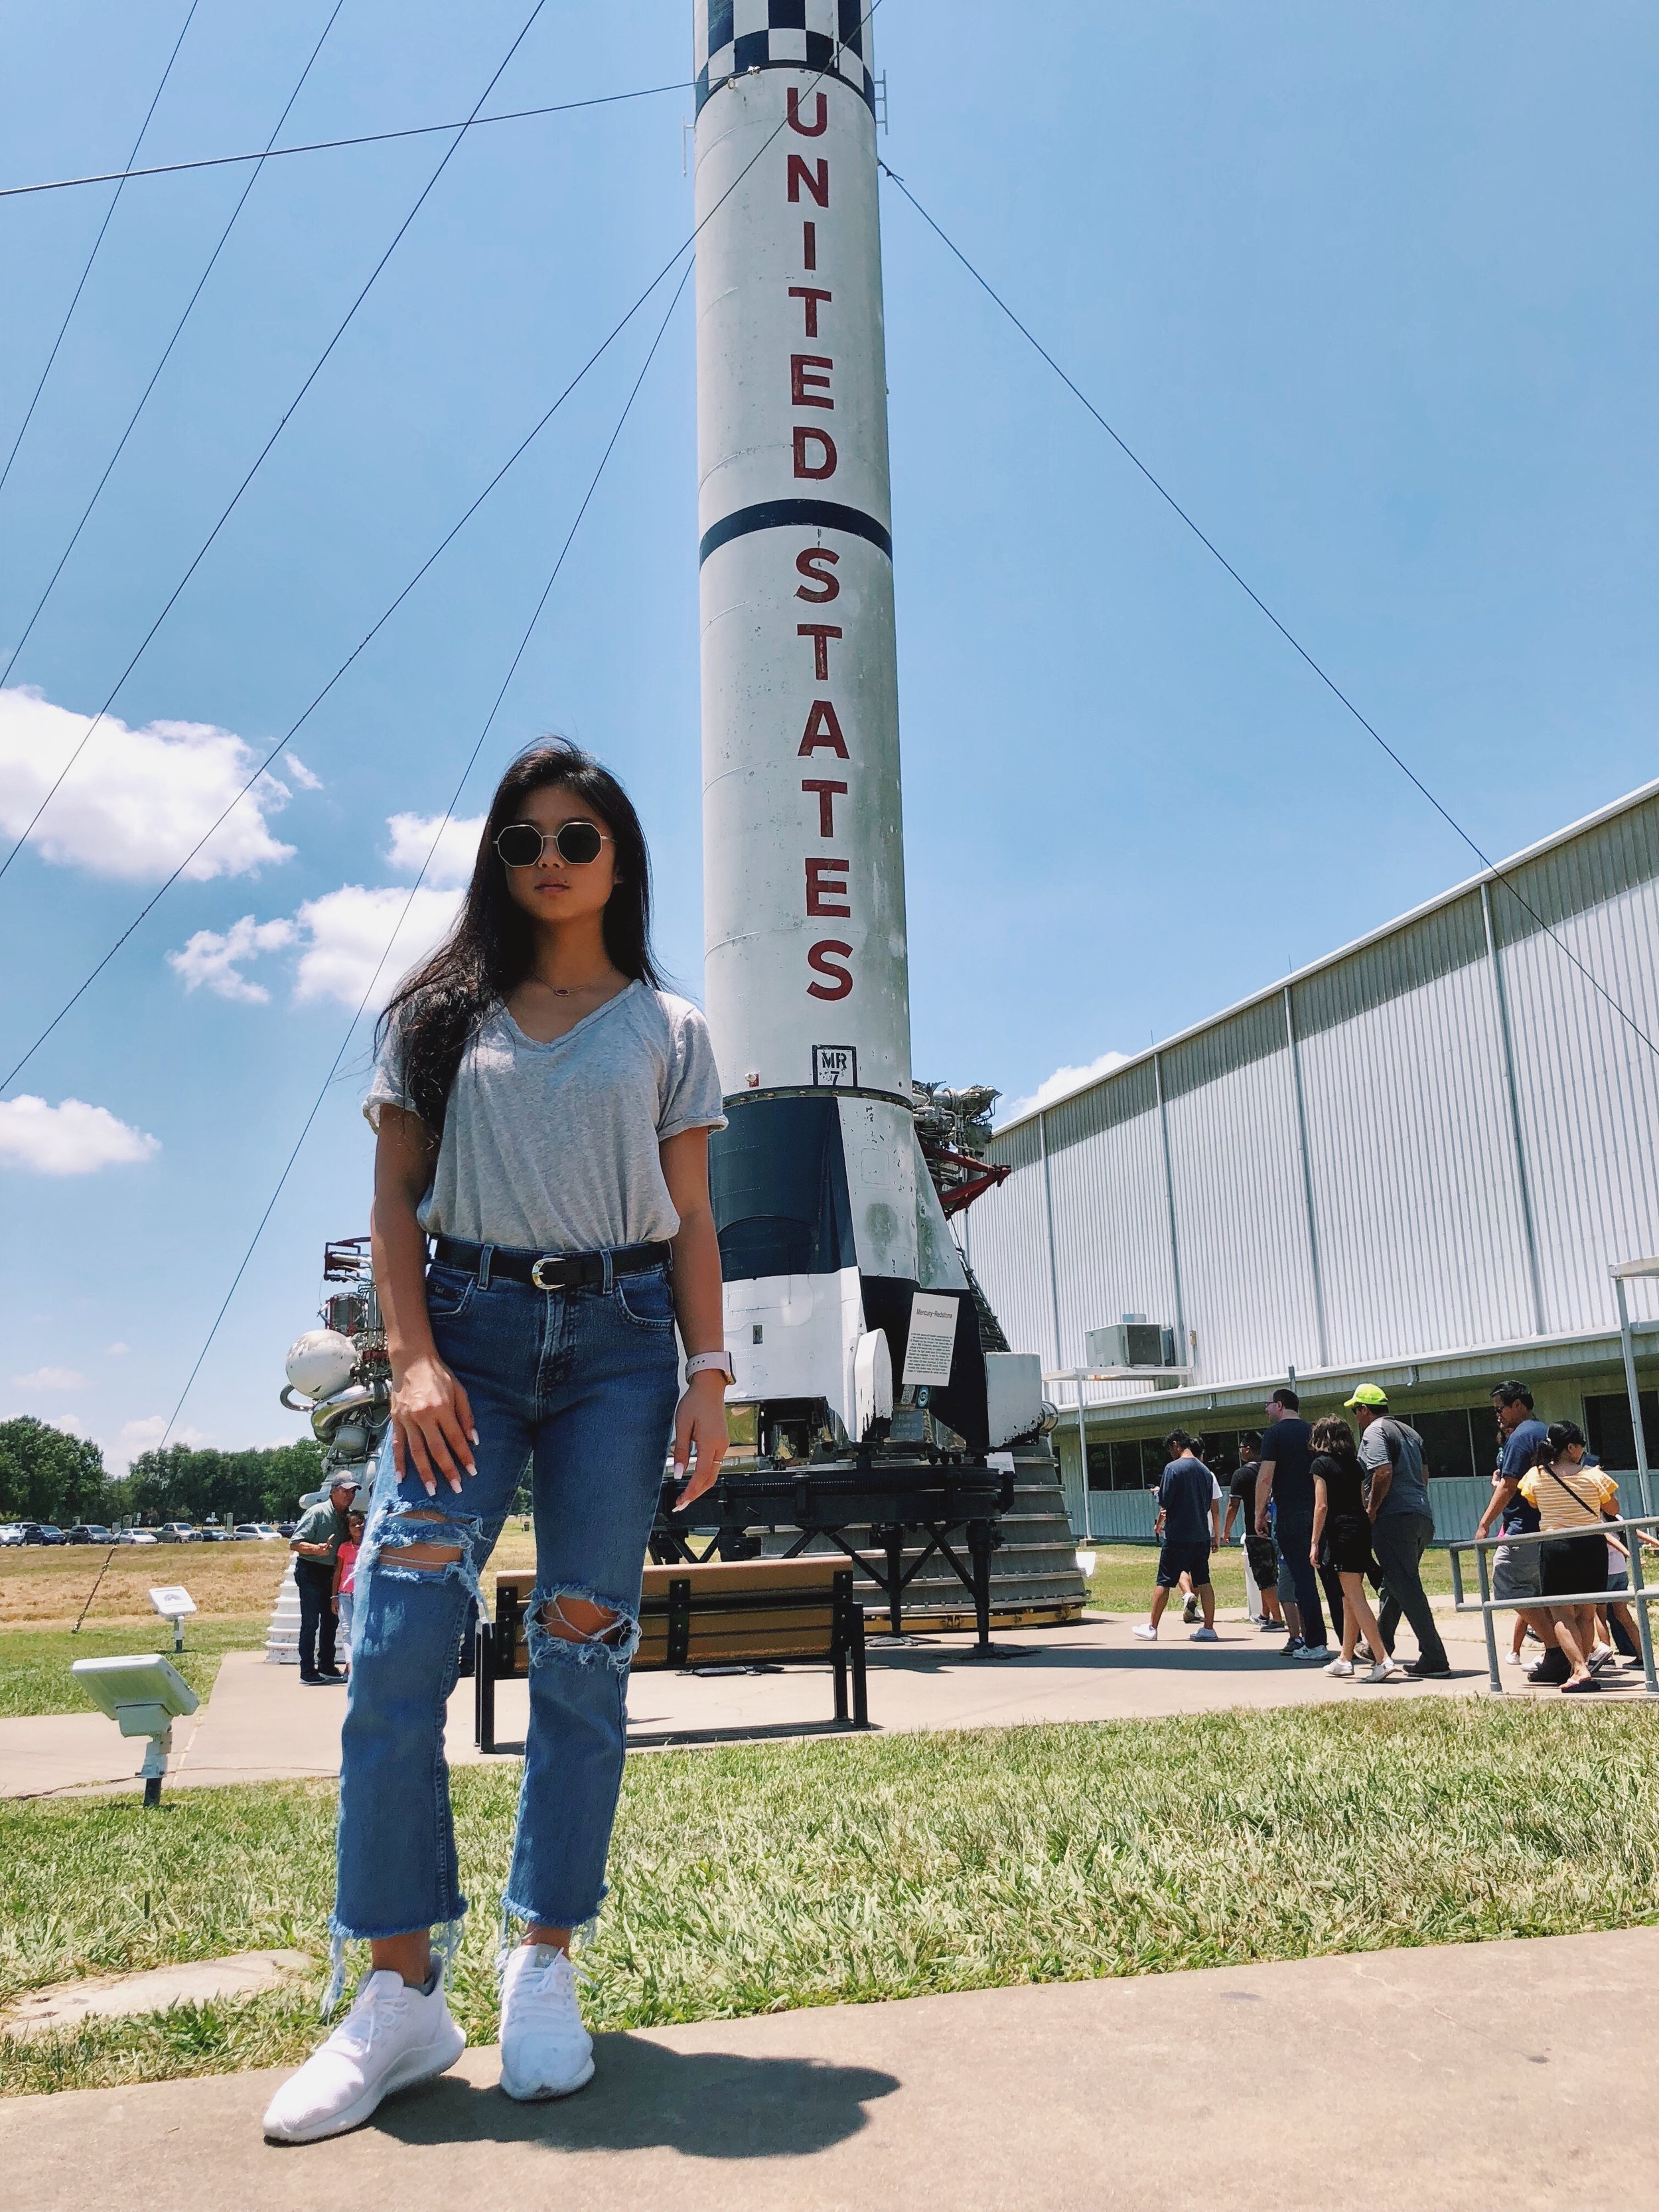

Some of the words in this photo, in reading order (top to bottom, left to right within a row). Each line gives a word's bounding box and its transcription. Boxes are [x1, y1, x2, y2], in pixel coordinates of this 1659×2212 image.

[786, 87, 837, 480] UNITED
[796, 548, 854, 1001] STATES
[822, 1052, 847, 1069] MR
[830, 1070, 839, 1086] 7
[916, 1308, 953, 1319] Mercury-Redstone
